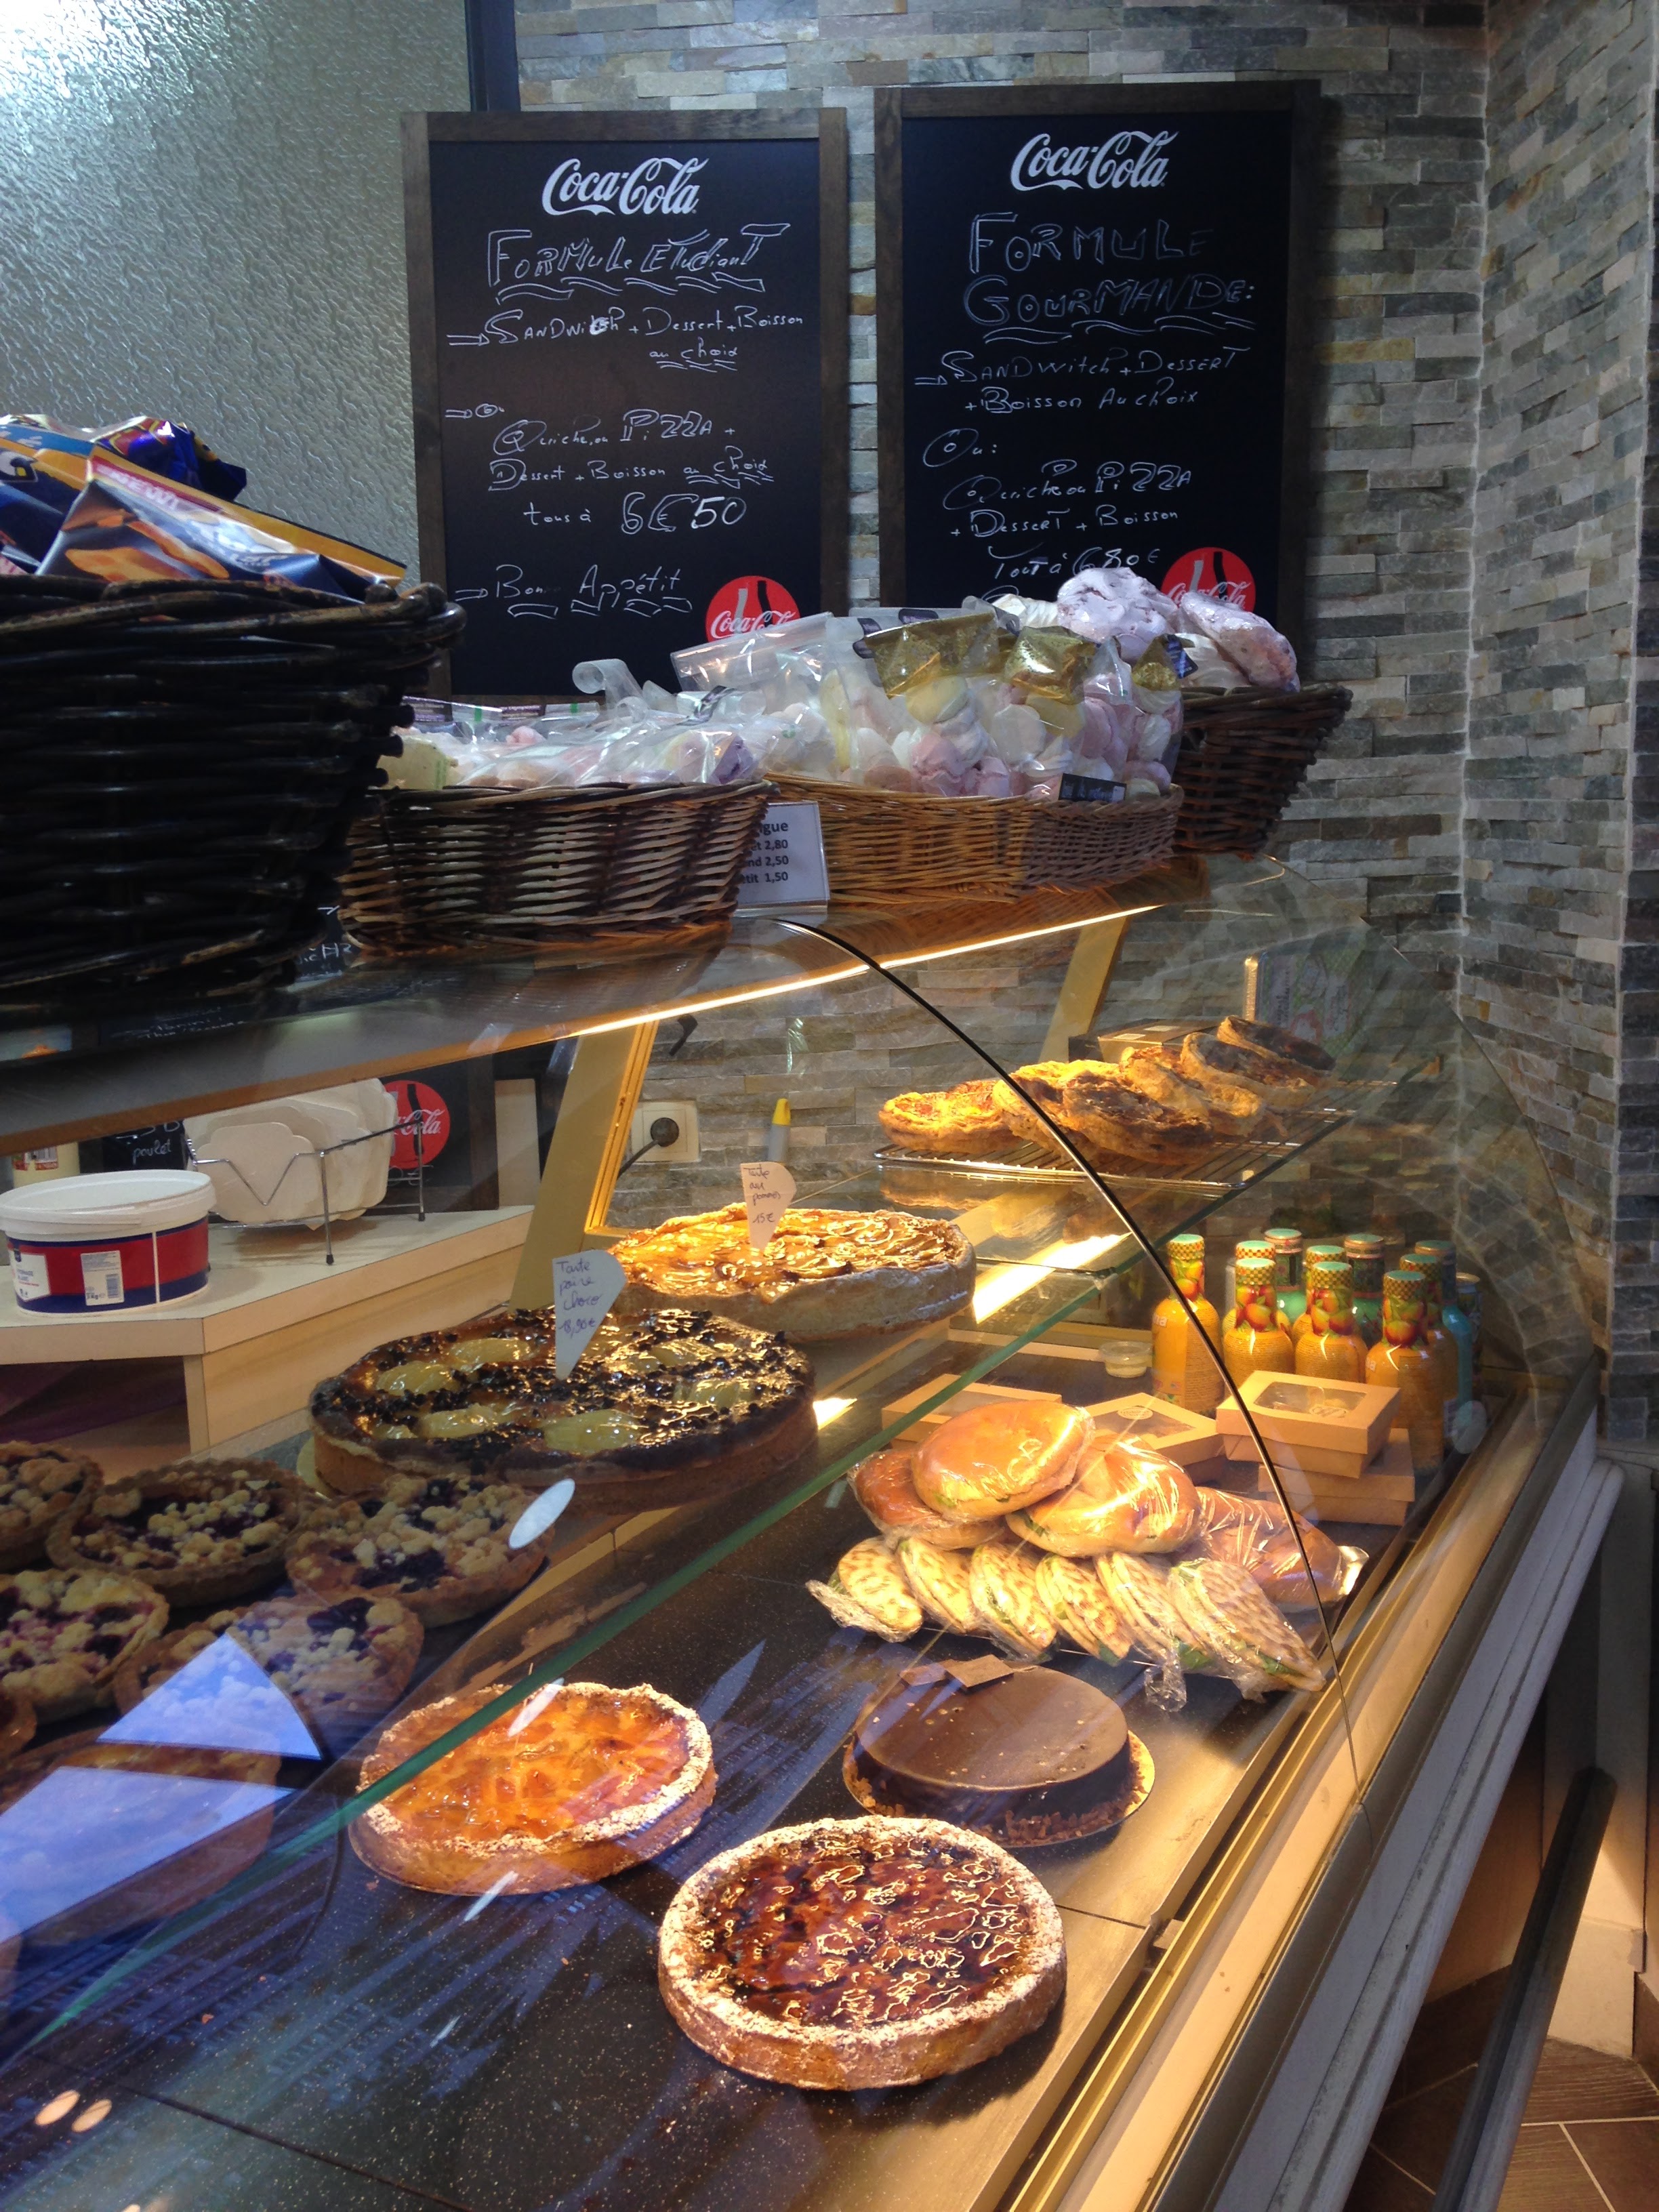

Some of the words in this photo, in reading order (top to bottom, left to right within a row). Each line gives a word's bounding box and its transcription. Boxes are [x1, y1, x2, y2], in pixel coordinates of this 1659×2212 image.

[1010, 130, 1180, 192] Coca-Cola
[541, 157, 710, 216] Coca-Cola
[642, 306, 723, 335] Dessert
[764, 839, 789, 852] 2,80
[765, 855, 790, 867] 2,50
[764, 871, 789, 884] 1,50
[131, 1138, 173, 1166] poulet
